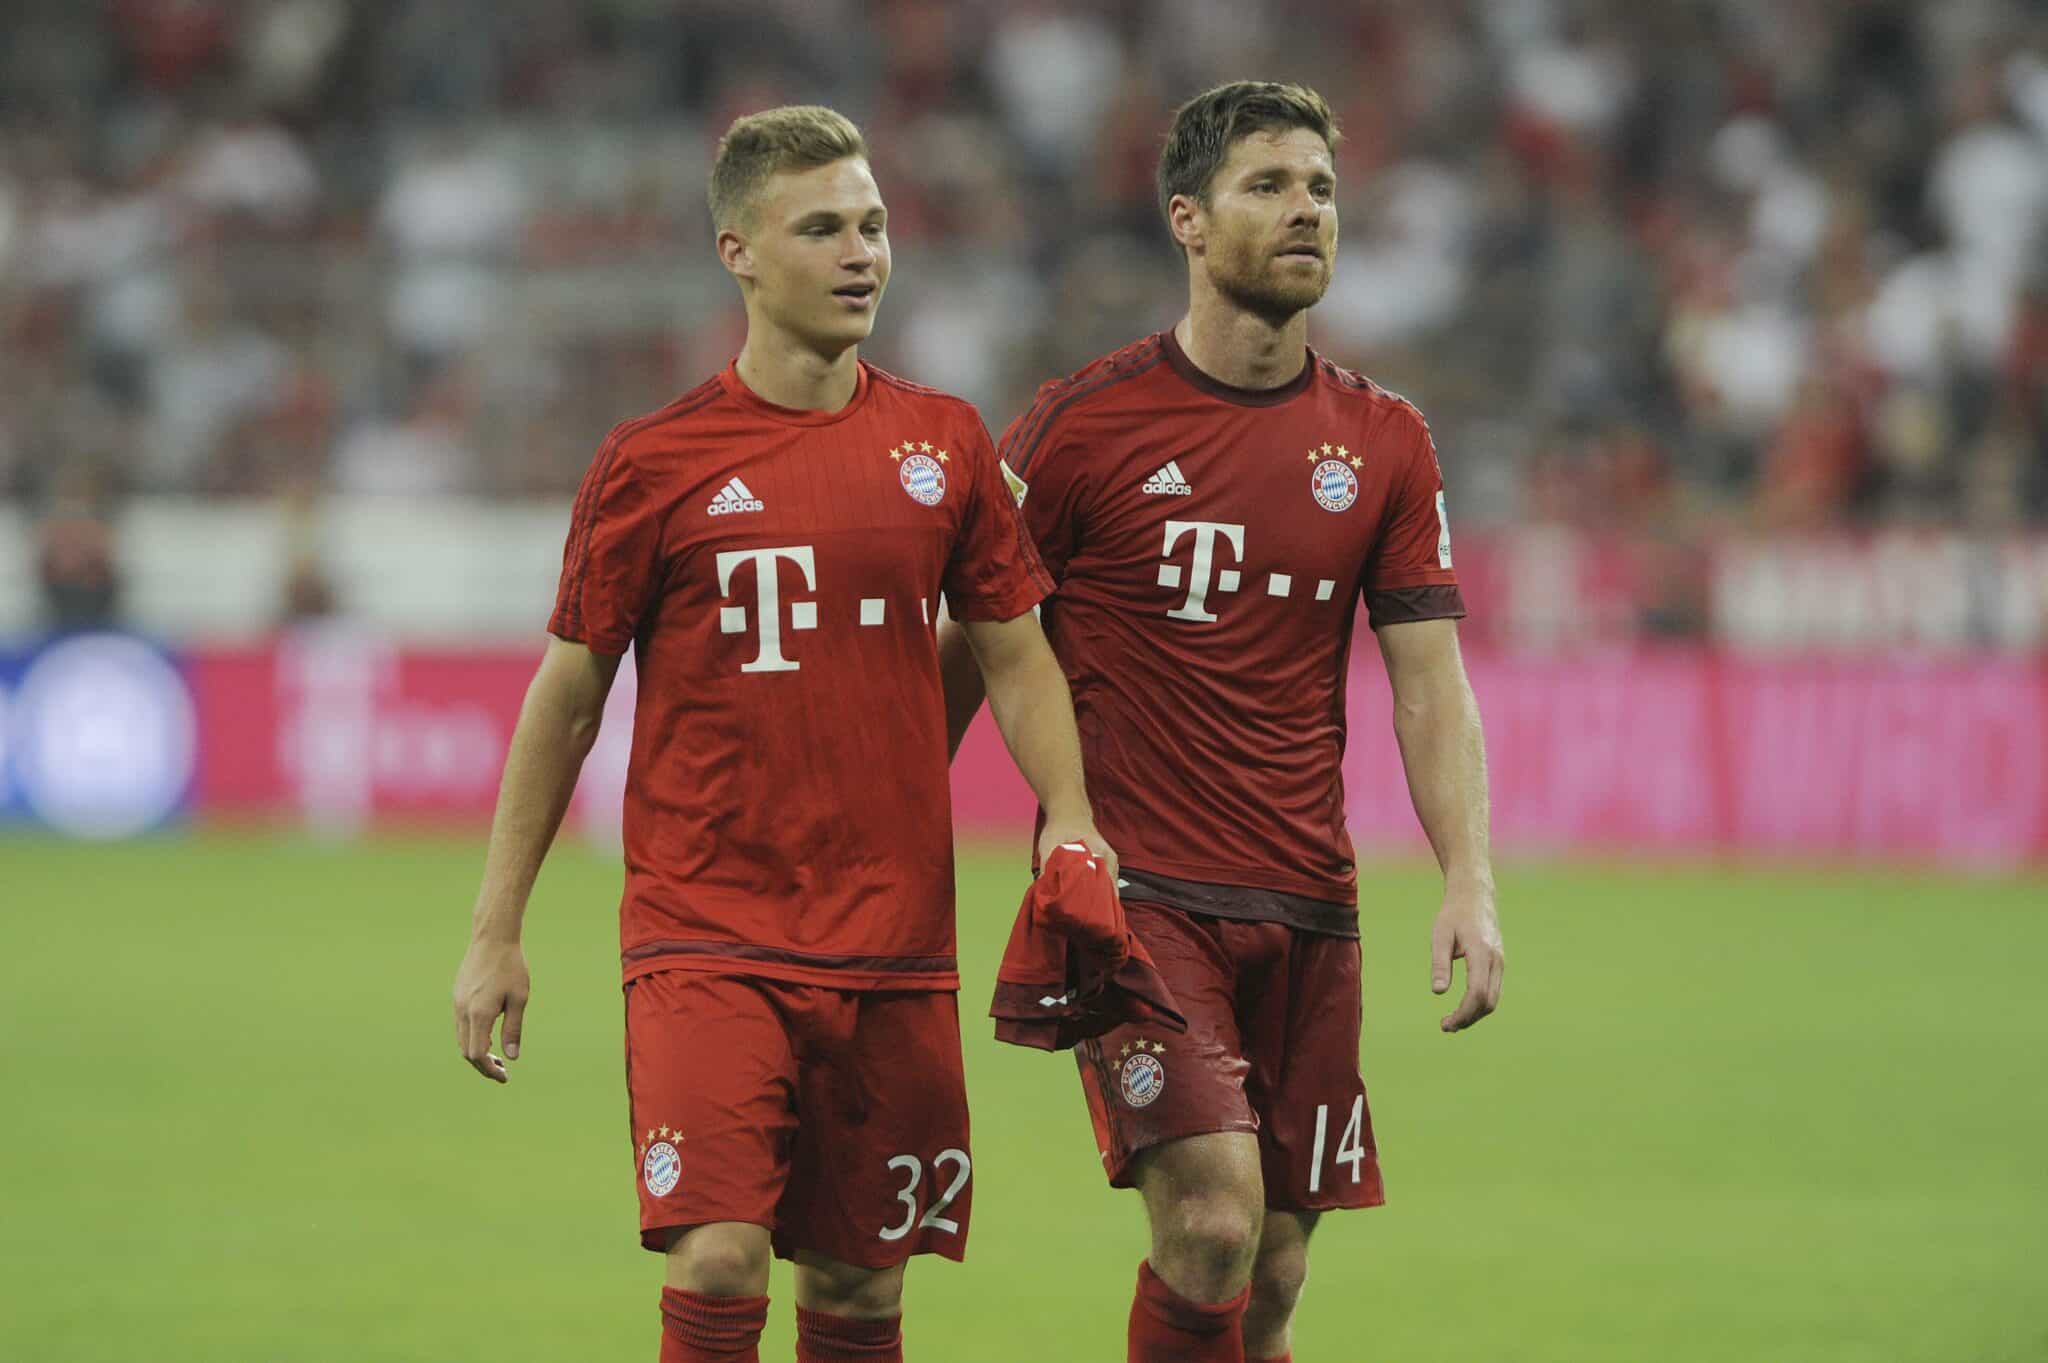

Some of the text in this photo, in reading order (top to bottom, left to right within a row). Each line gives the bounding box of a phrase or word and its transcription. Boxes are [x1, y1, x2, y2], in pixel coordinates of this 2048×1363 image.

[707, 499, 764, 516] adidas
[1142, 480, 1192, 495] adidas
[1323, 462, 1355, 484] BAYERN
[716, 546, 816, 672] T
[1160, 520, 1245, 622] T
[1309, 1094, 1365, 1192] 14
[879, 1149, 971, 1241] 32
